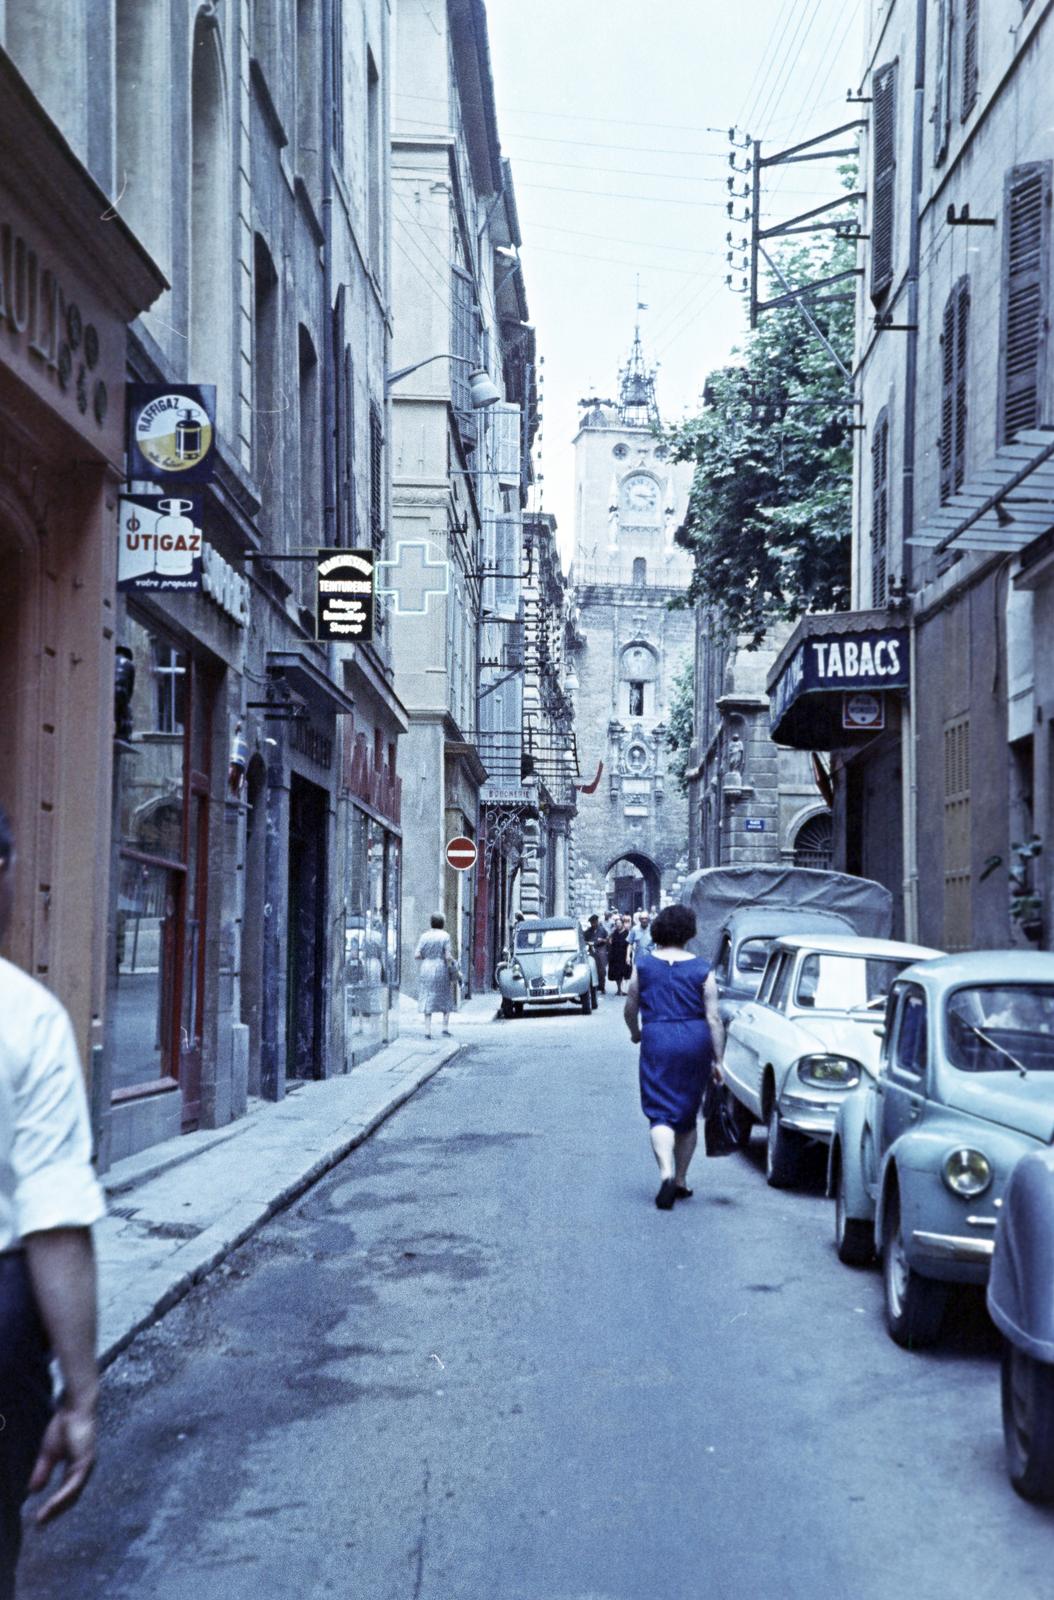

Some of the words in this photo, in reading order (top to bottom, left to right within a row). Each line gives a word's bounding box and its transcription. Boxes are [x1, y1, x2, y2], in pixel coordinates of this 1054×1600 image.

[138, 397, 180, 432] RAFFIGAZ
[126, 534, 201, 551] UTIGAZ
[135, 579, 159, 587] votre
[160, 580, 198, 589] propane
[319, 580, 372, 593] TEINTURERIE
[329, 621, 363, 634] Stoppage
[812, 639, 901, 678] TABACS
